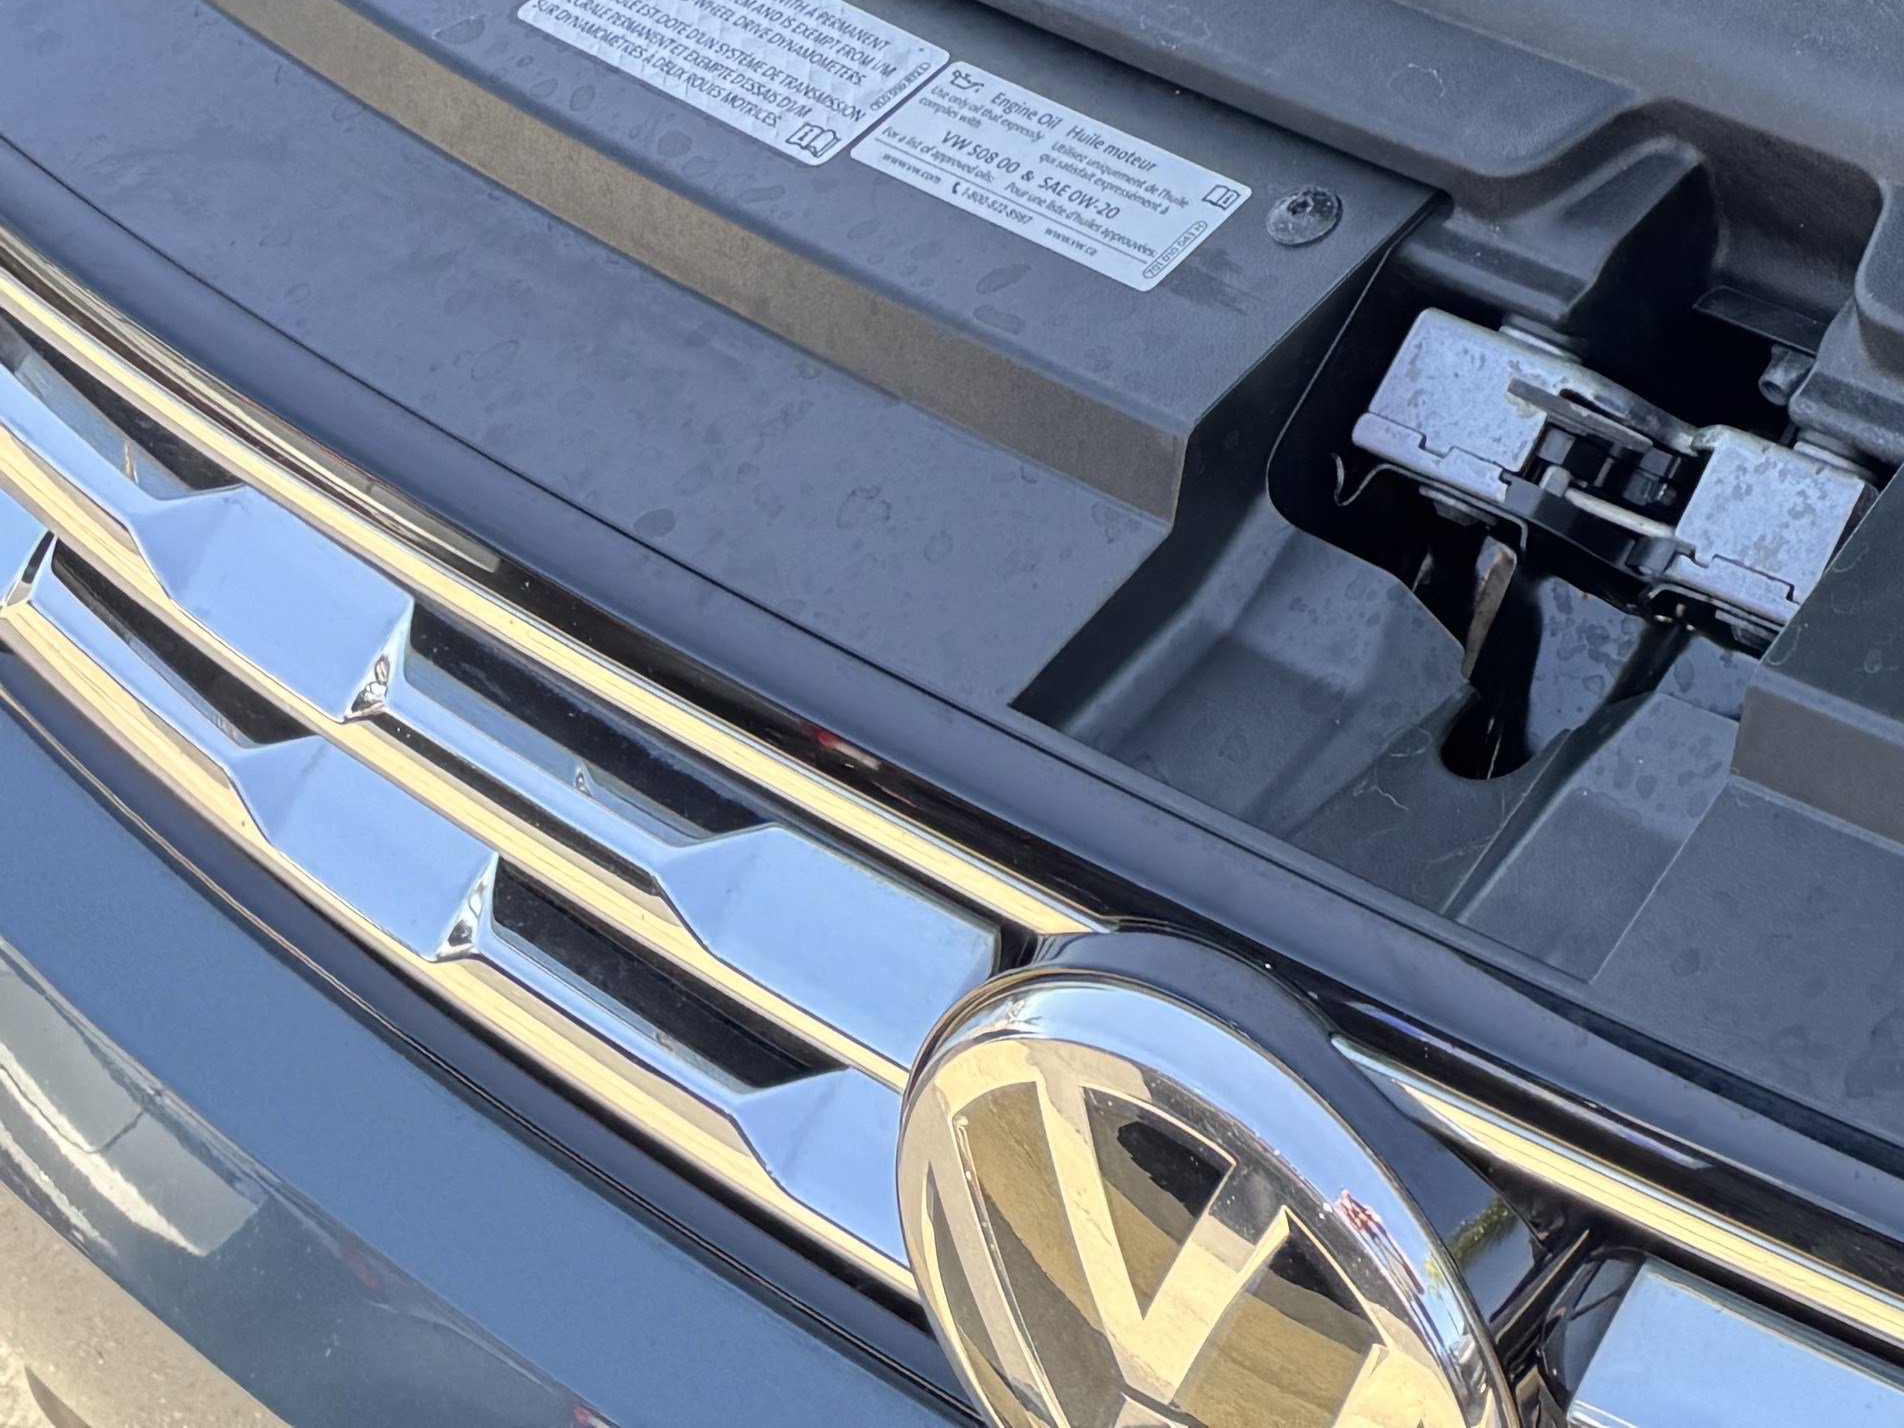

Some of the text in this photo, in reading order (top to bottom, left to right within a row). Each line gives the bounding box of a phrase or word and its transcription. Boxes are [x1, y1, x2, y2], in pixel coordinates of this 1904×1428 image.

[607, 11, 676, 49] PERMANENT
[733, 16, 772, 38] DRIVE
[753, 3, 784, 22] AND
[792, 22, 841, 50] EXEMPT
[837, 44, 875, 66] FROM
[815, 11, 890, 51] PERMANENT
[637, 3, 661, 18] EST
[762, 65, 784, 80] DE
[779, 74, 867, 121] TRANSMISSION
[652, 57, 688, 79] DEUX
[684, 73, 726, 98] ROUES
[990, 92, 1158, 172] Engine Oil Huile moteur
[941, 131, 1121, 219] VW 508 00 & SAE 0W-20
